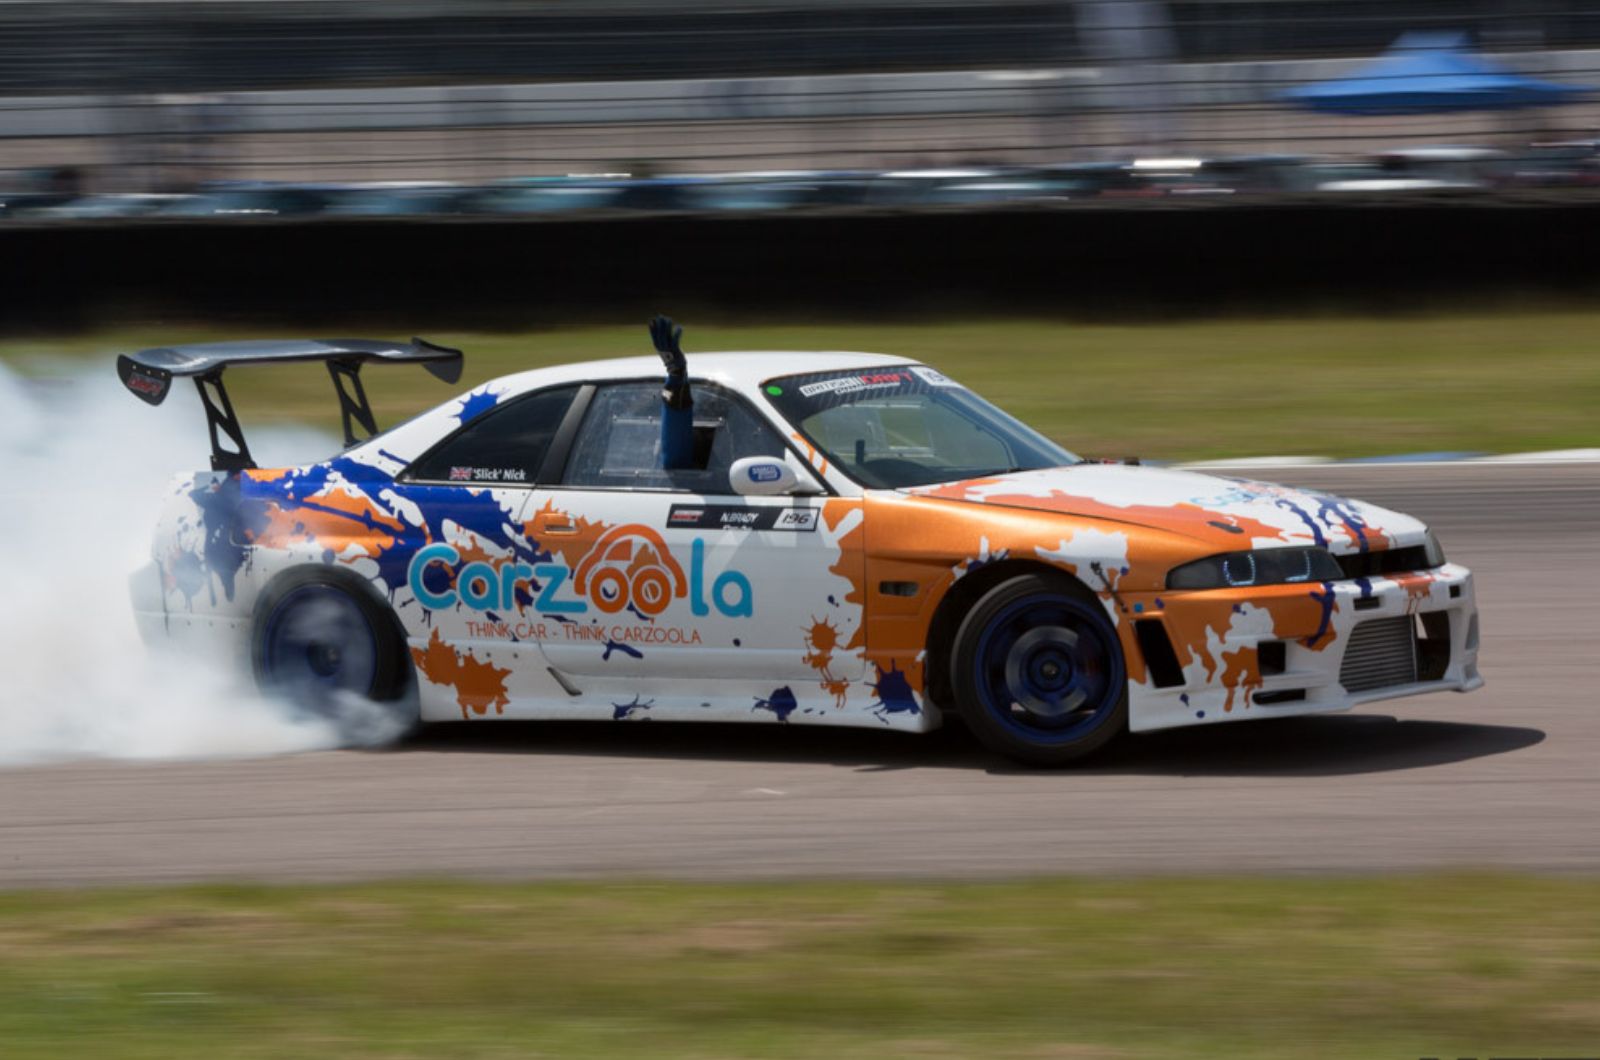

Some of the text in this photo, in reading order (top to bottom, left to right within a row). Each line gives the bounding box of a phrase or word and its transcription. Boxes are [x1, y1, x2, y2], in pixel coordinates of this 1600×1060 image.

[503, 469, 526, 480] Nick
[782, 512, 811, 524] 196
[408, 537, 754, 618] Carzoola
[465, 621, 513, 638] THINK
[515, 623, 547, 639] CAR
[562, 623, 608, 641] THINK
[610, 625, 703, 644] CARZOOLA
